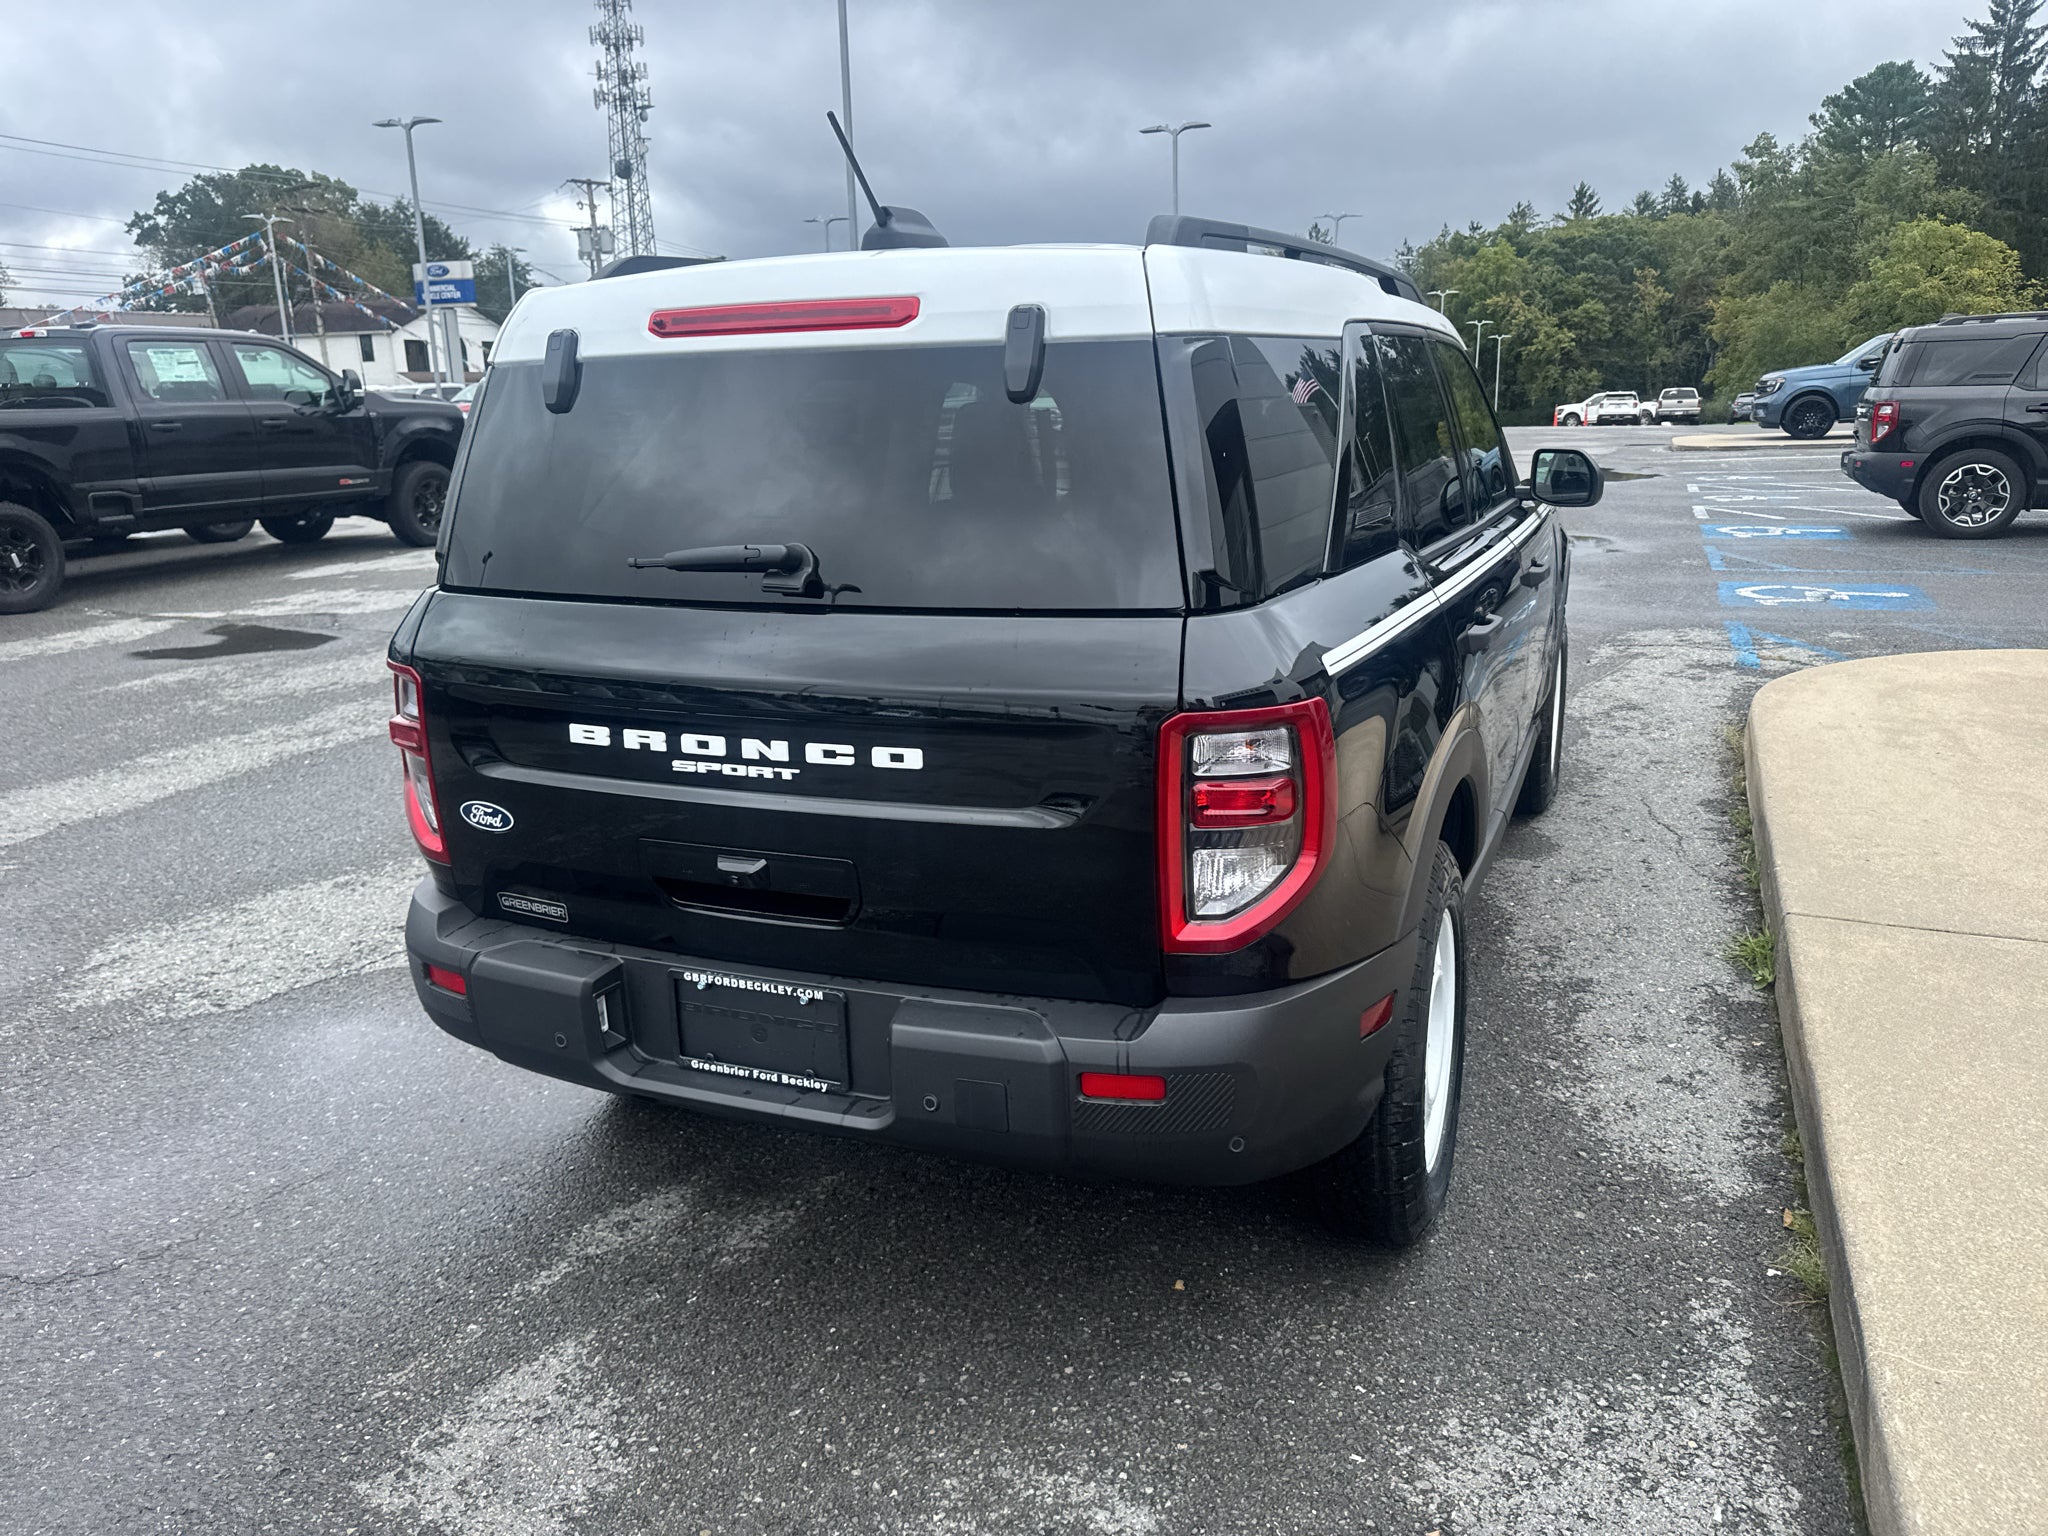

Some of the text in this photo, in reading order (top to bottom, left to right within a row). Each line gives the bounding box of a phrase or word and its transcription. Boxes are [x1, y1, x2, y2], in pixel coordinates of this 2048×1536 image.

[422, 284, 456, 292] MMERCIAL
[441, 290, 461, 299] CENTER
[568, 723, 924, 770] BRONCO
[672, 759, 800, 780] SPORT
[469, 804, 503, 828] Ford
[501, 896, 566, 918] GREENBRIER
[683, 972, 824, 1001] GBRFORDBECKLEY.COM
[691, 1060, 828, 1093] Greenbrier Ford Beckley
